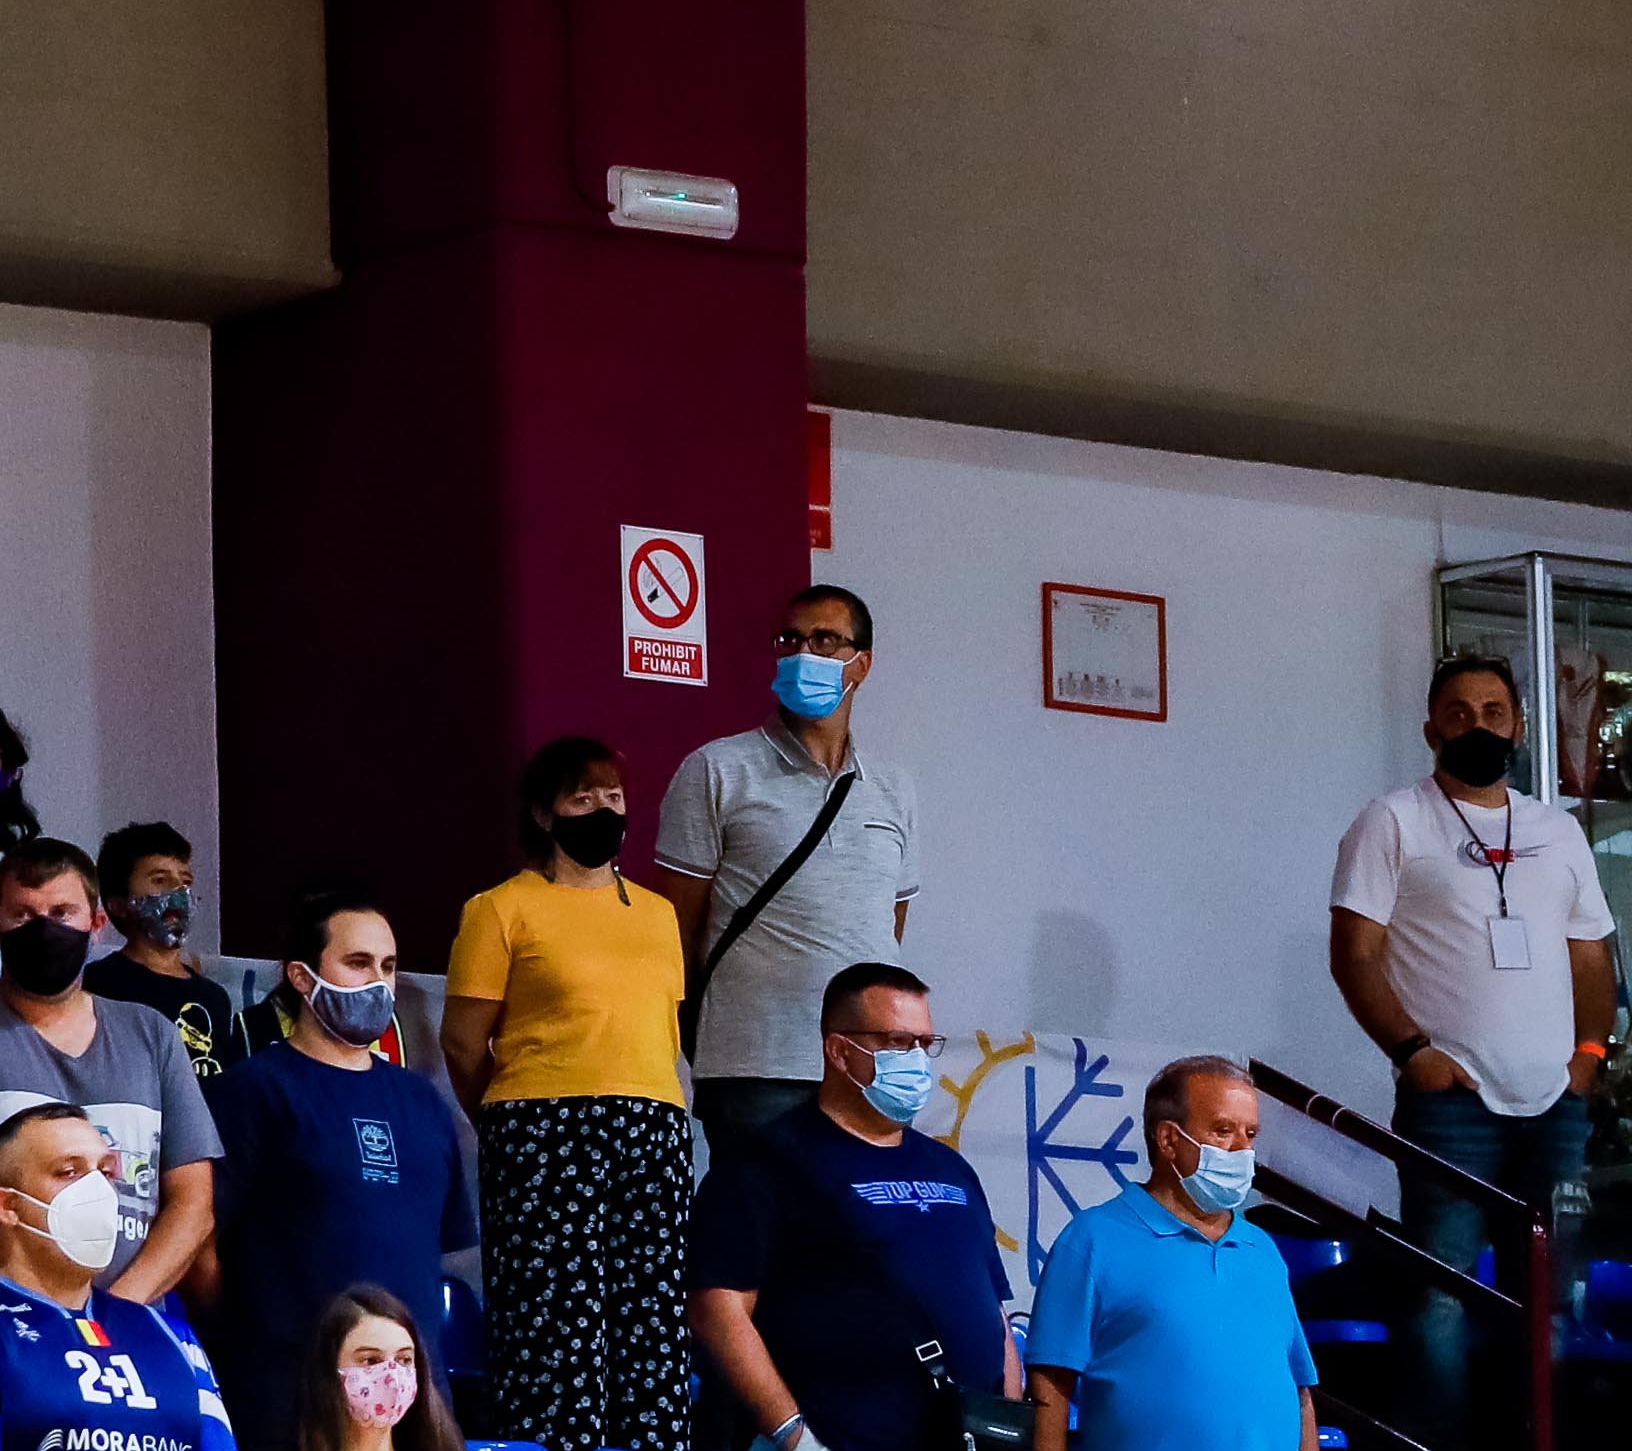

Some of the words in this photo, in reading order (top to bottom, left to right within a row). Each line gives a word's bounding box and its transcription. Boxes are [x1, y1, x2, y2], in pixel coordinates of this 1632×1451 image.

[634, 639, 697, 661] PROHIBIT
[641, 656, 691, 676] FUMAR
[879, 1181, 913, 1199] TOP
